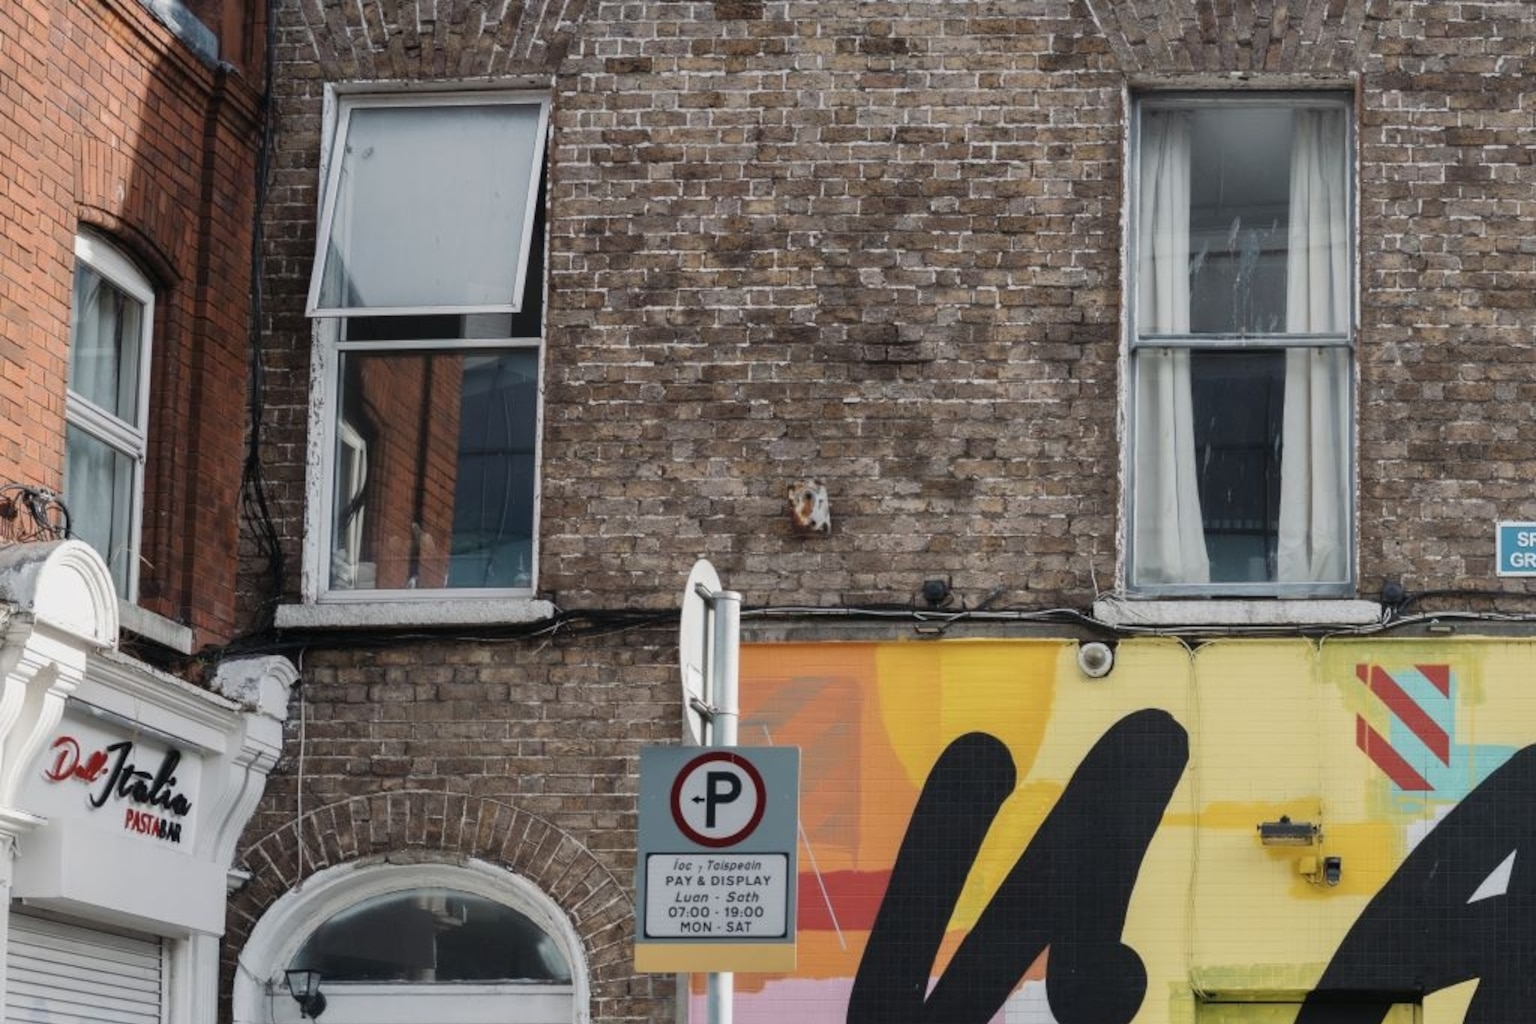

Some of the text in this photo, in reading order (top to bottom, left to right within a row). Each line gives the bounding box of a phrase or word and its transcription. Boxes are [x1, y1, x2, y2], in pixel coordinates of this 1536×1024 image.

[705, 771, 742, 828] P
[665, 875, 771, 886] PAY & DISPLAY
[675, 891, 709, 903] Luan
[726, 891, 759, 903] Sath
[668, 906, 710, 918] 07:00
[724, 906, 764, 918] 19:00
[680, 921, 712, 933] MON
[726, 921, 752, 933] SAT
